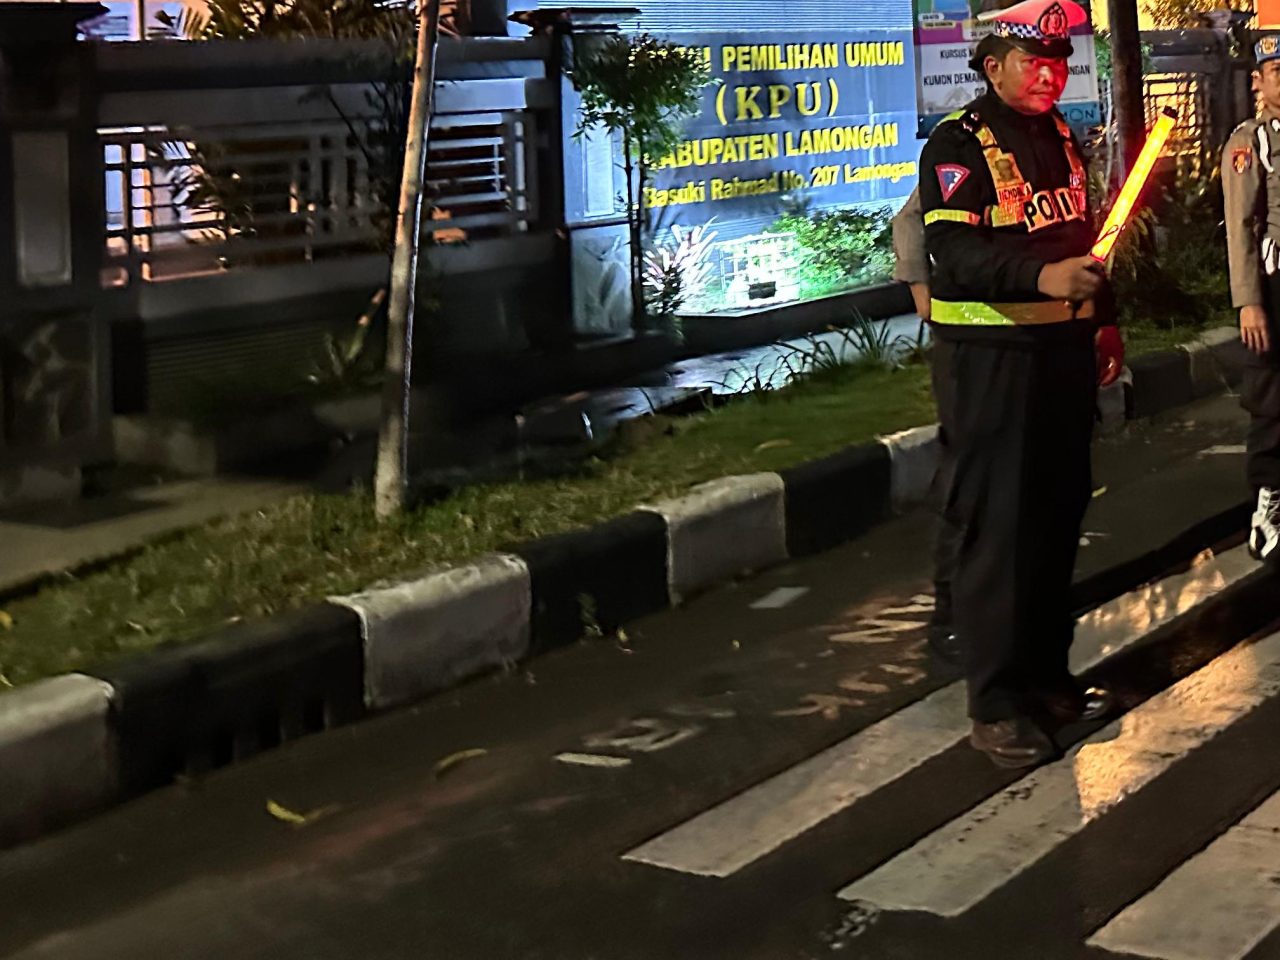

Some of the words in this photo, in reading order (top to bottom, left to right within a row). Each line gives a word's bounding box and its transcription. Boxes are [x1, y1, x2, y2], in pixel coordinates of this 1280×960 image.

[722, 43, 839, 72] PEMILIHAN
[845, 41, 904, 68] UMUM
[940, 47, 968, 59] KURSUS
[923, 74, 953, 86] KUMON
[715, 78, 839, 125] (KPU)
[644, 132, 779, 170] ABUPATEN
[785, 123, 898, 157] LAMONGAN
[643, 181, 706, 208] Basuki
[782, 169, 809, 191] No.
[811, 165, 840, 188] 207
[844, 161, 917, 185] Lamongan
